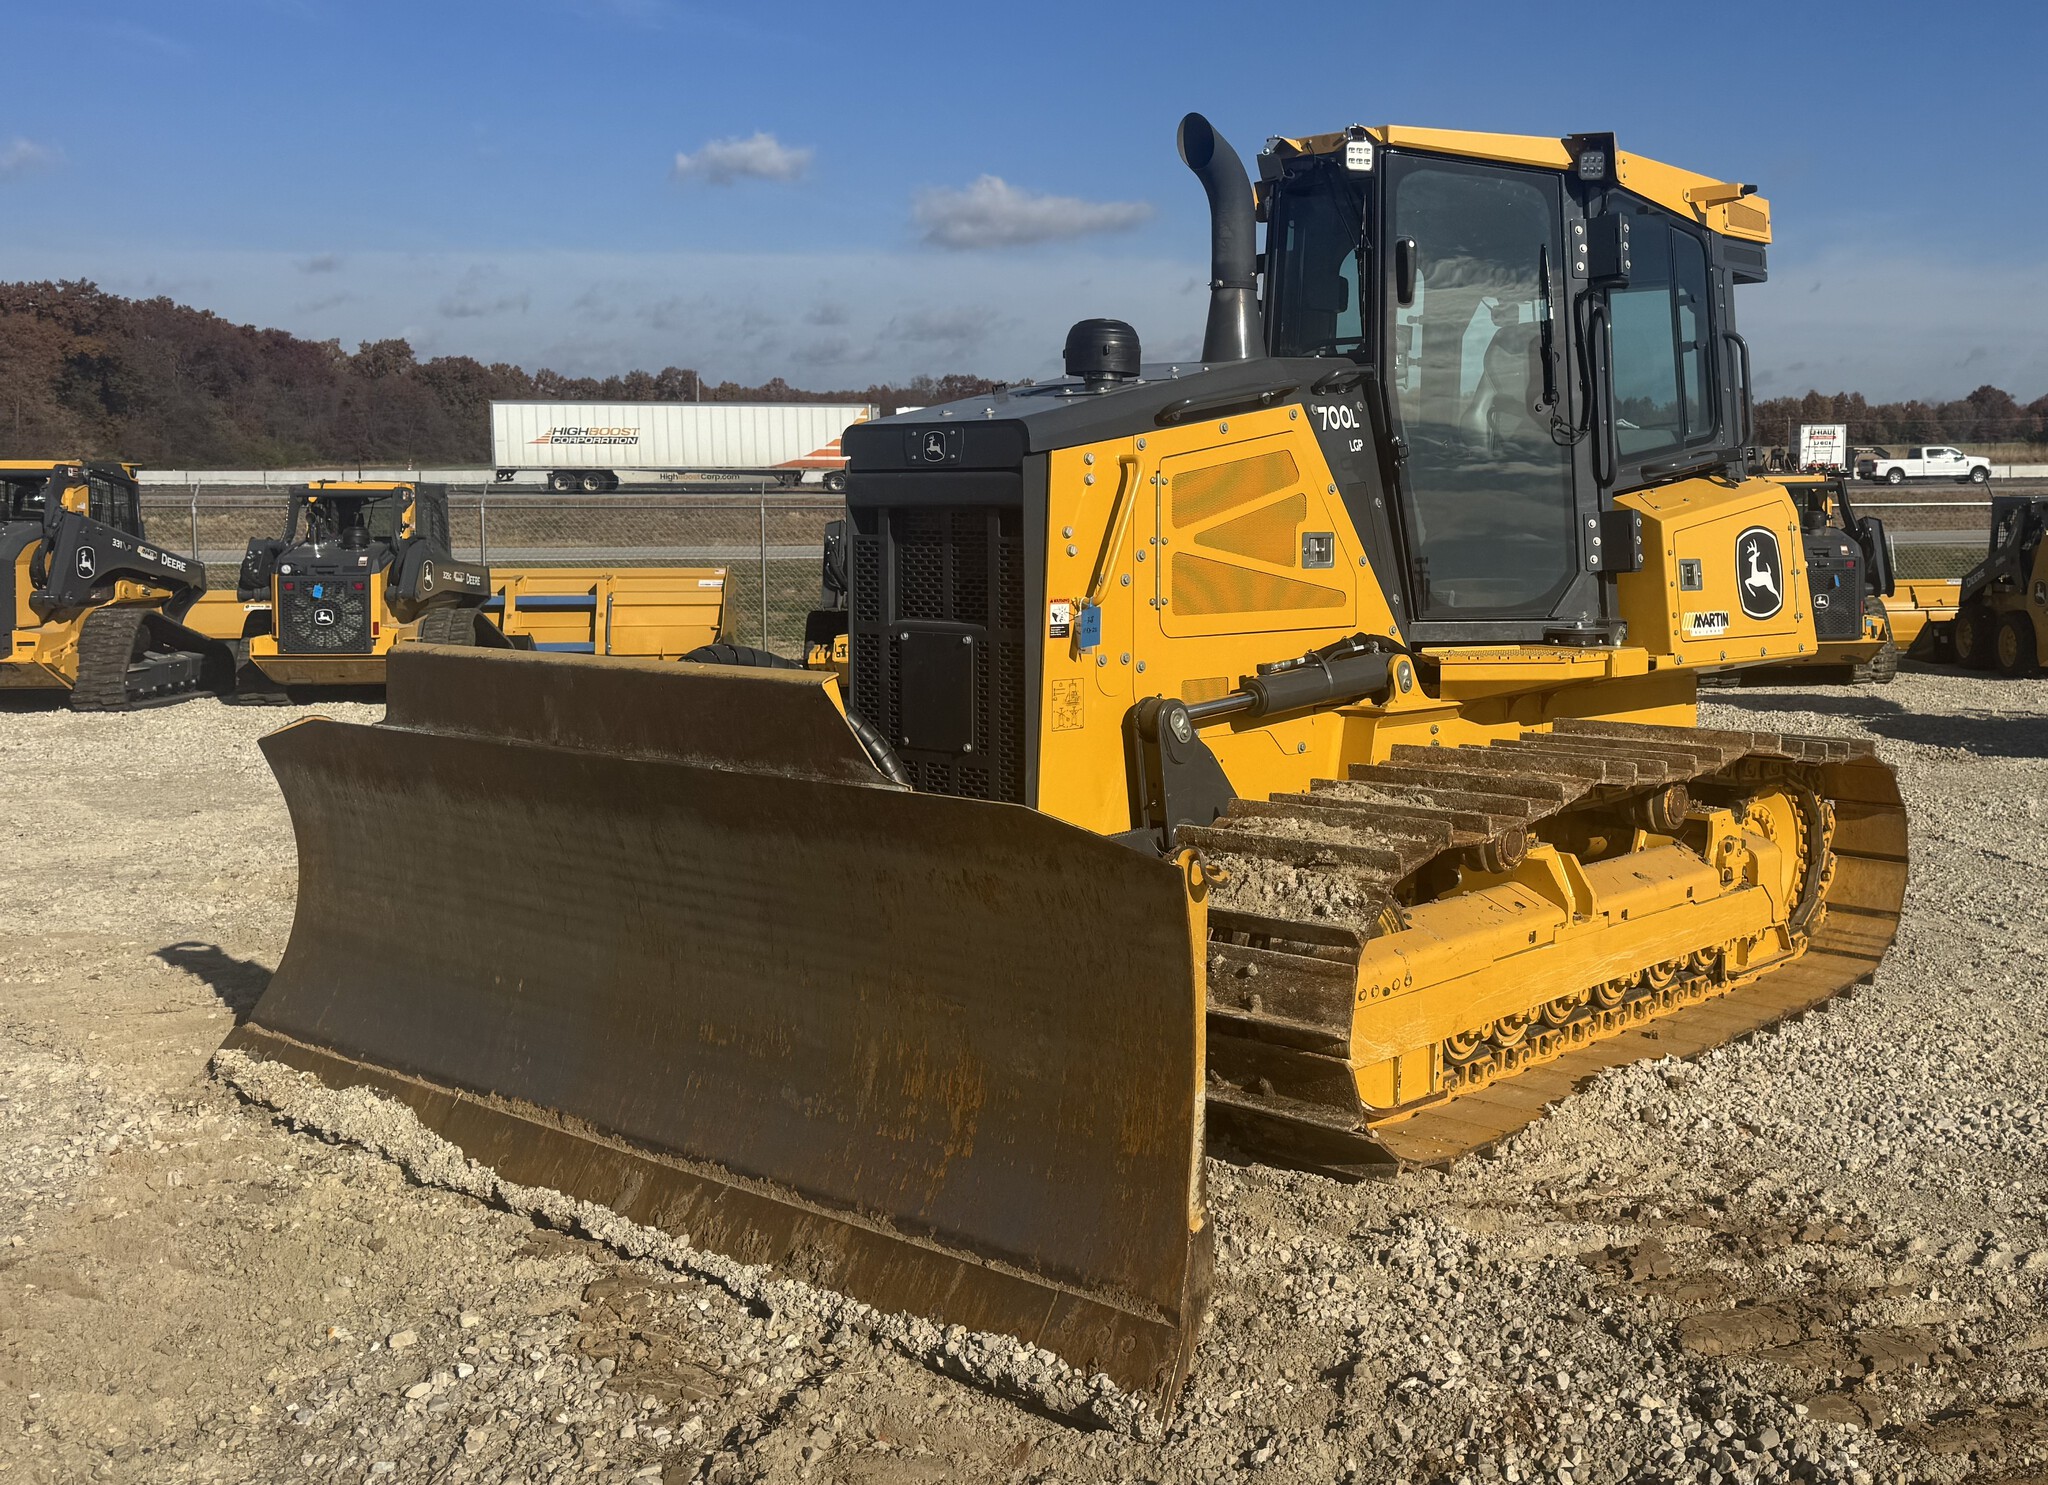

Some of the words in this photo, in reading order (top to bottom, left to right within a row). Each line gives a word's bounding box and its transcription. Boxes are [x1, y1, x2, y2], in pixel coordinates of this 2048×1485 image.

[1317, 404, 1360, 431] 700L
[552, 427, 640, 436] HIGHBOOST
[1349, 439, 1363, 452] LGP
[161, 553, 187, 573] DEERE
[1693, 612, 1729, 629] MARTIN
